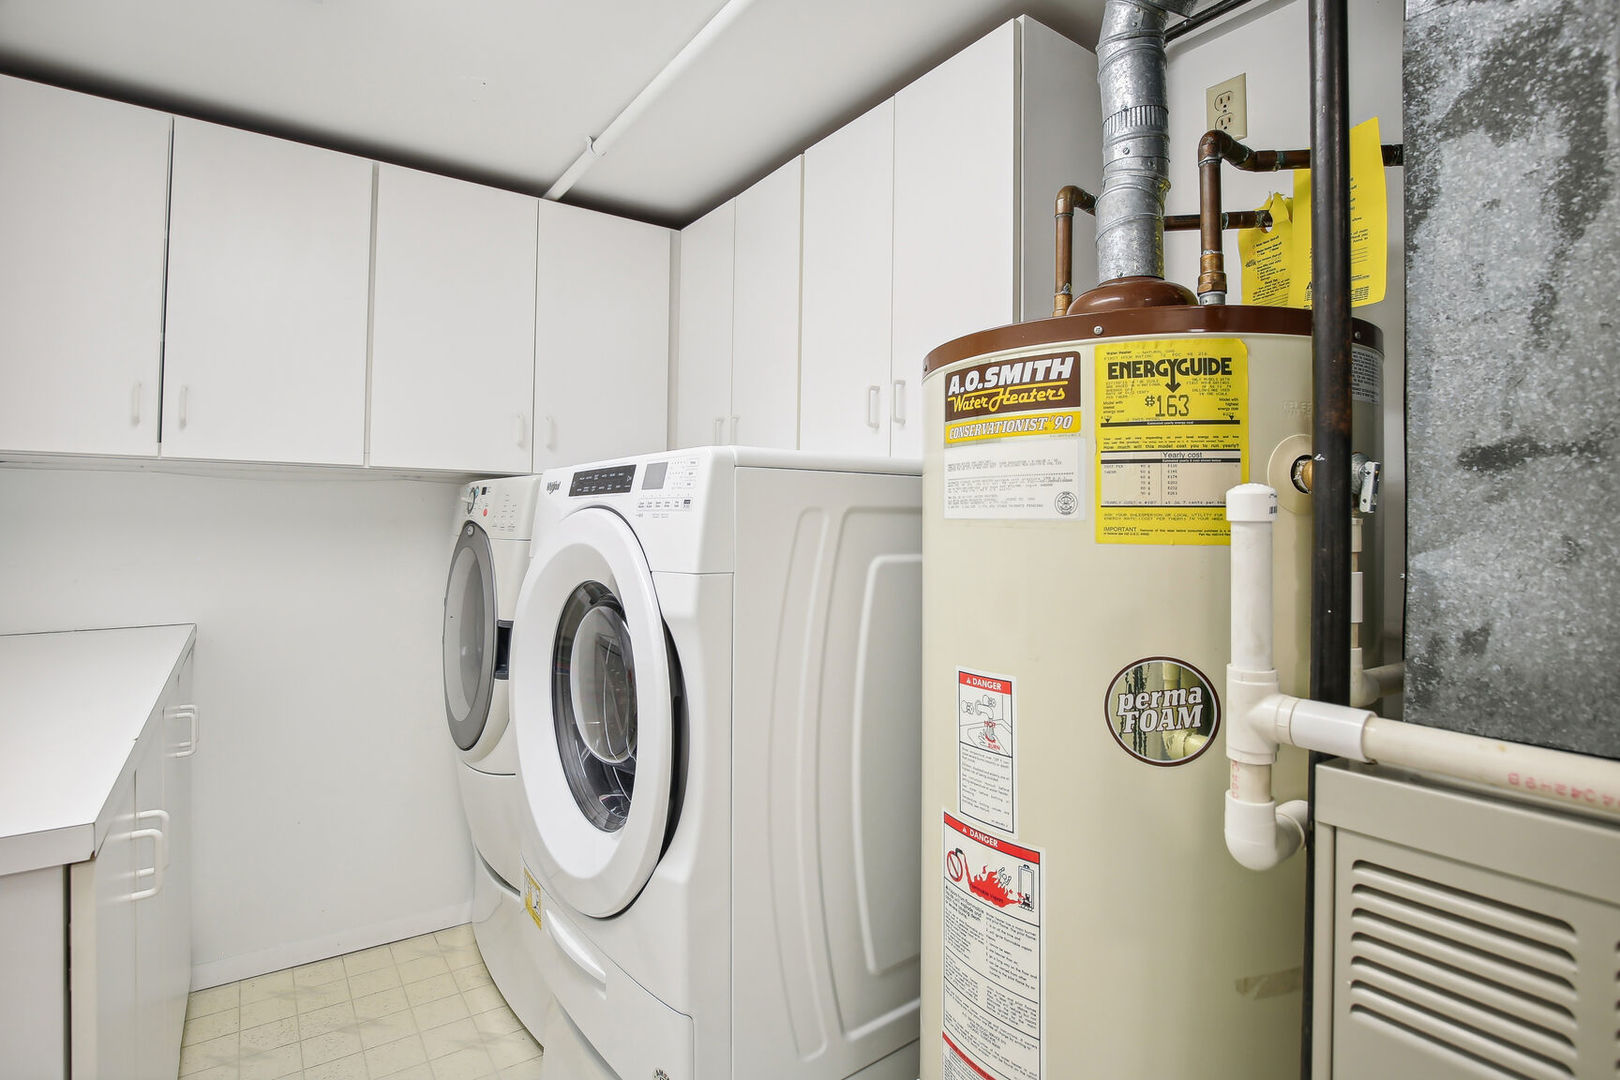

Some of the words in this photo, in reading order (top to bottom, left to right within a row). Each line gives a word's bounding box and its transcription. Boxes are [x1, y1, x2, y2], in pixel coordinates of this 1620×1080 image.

[948, 356, 1075, 397] A.O.SMITH
[1107, 357, 1232, 381] ENERGYGUIDE
[948, 394, 989, 413] Water
[988, 382, 1067, 413] Heaters
[949, 418, 1049, 440] CONSERVATIONIST
[972, 678, 1002, 691] DANGER
[1117, 686, 1203, 717] perma
[984, 720, 996, 728] HOT
[1122, 704, 1204, 734] FOAM
[969, 827, 999, 848] DANGER
